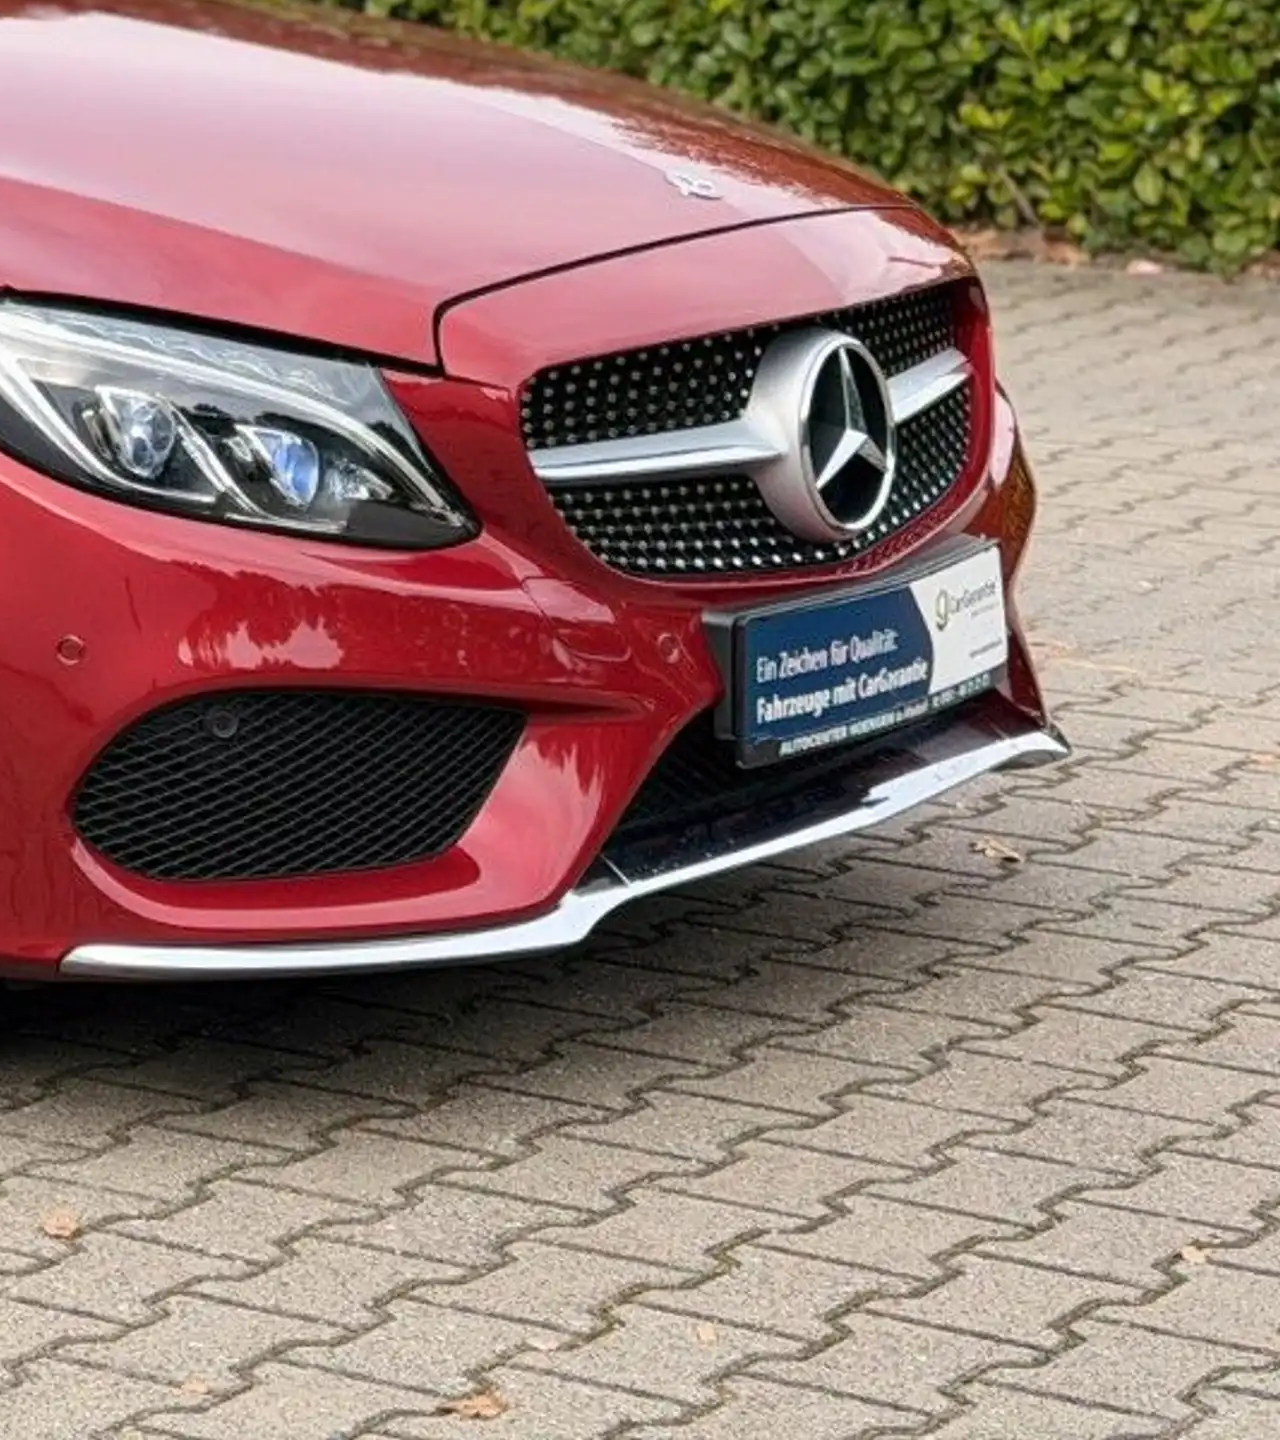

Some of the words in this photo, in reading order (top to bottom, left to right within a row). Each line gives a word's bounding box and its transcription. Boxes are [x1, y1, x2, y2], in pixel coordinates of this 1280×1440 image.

[756, 656, 777, 683] Ein
[779, 646, 828, 679] Zeichen
[830, 639, 849, 666] für
[756, 688, 831, 724] Fahrzeuge
[833, 676, 857, 705] mit
